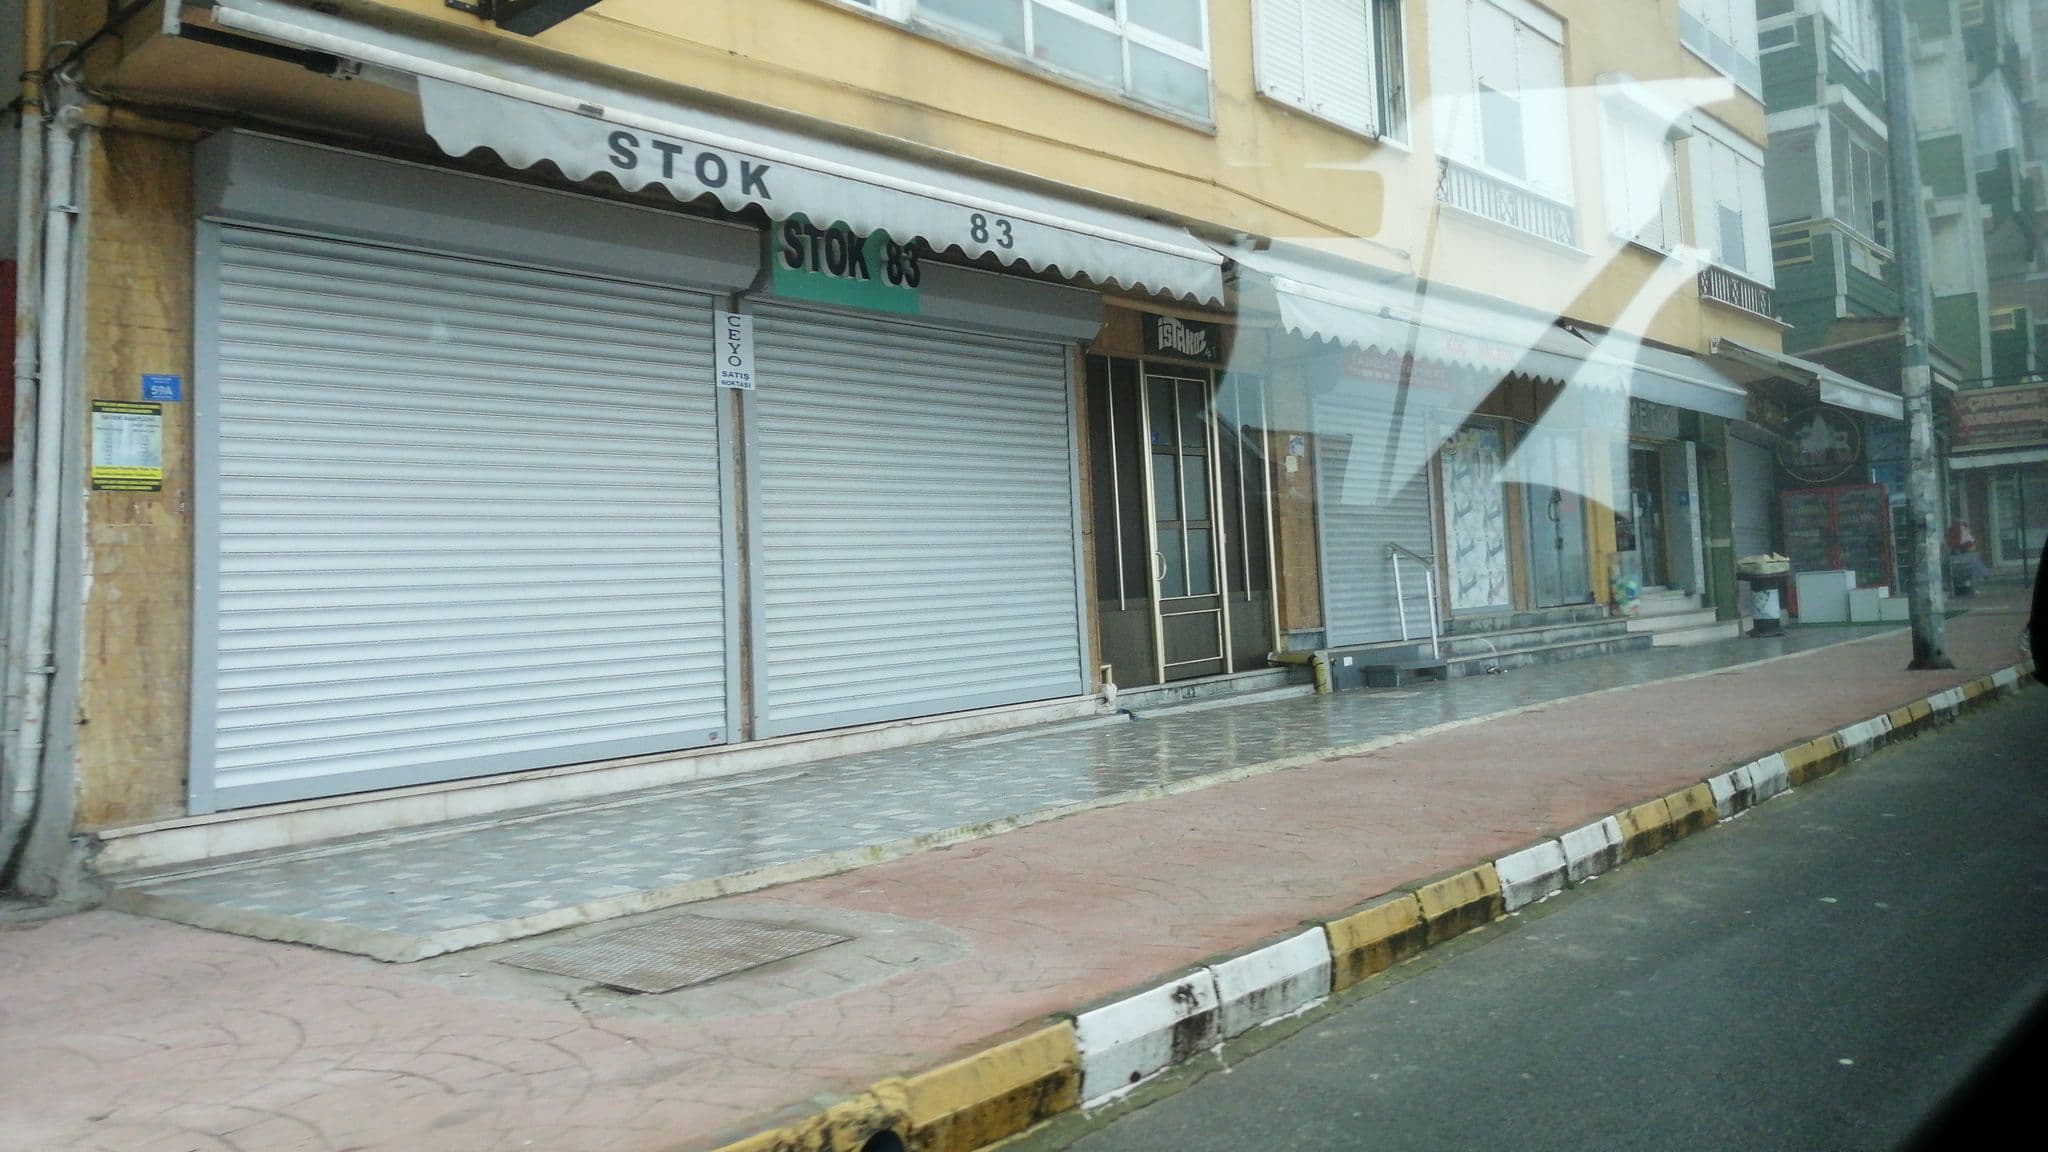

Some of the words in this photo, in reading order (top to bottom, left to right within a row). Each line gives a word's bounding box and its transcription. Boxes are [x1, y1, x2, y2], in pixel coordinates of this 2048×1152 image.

[608, 130, 772, 200] STOK
[970, 213, 1013, 249] 83
[779, 217, 870, 281] STOK
[882, 238, 921, 289] 83
[727, 315, 742, 367] CEYO
[150, 384, 173, 396] 59A
